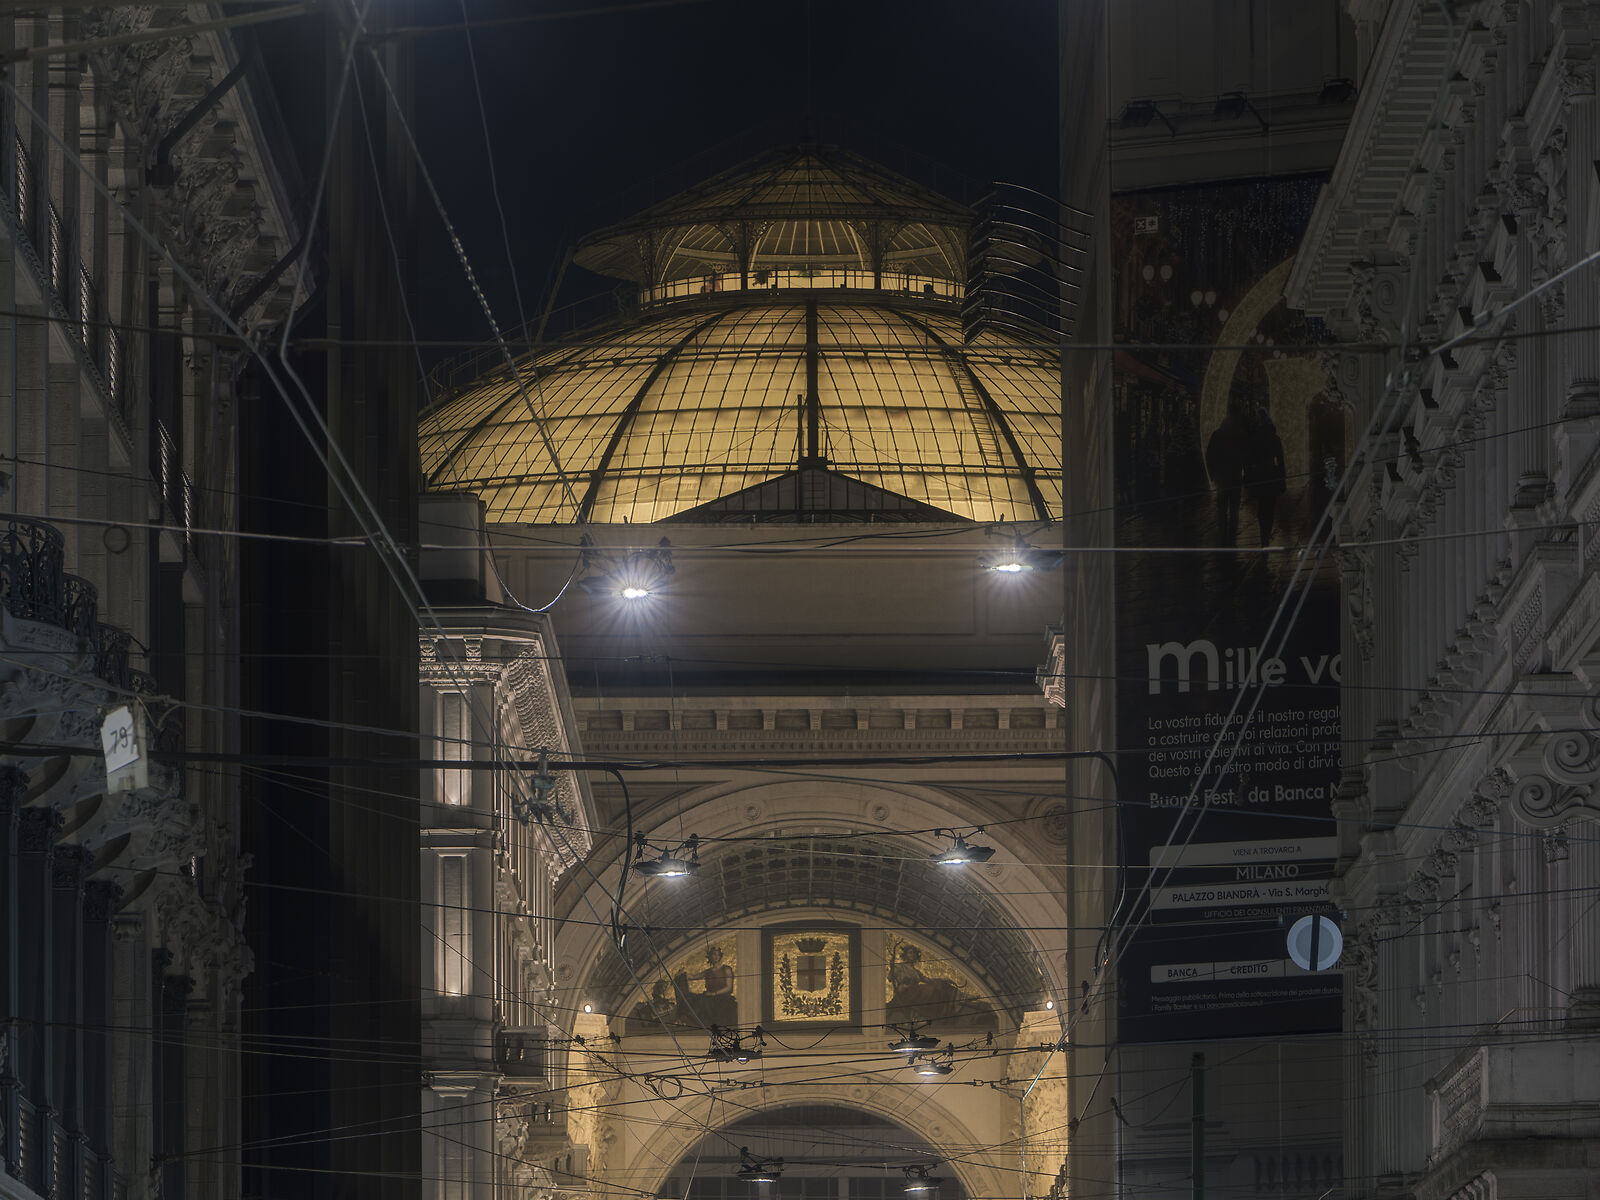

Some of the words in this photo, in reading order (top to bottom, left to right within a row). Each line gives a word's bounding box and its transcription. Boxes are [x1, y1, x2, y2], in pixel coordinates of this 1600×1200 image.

[1145, 639, 1287, 695] mille
[1148, 716, 1162, 730] La
[1166, 715, 1201, 729] vostra
[1258, 709, 1264, 723] il
[1268, 708, 1305, 722] nostro
[1308, 705, 1341, 722] regal
[1148, 736, 1156, 746] a
[1160, 730, 1210, 746] costruire
[1259, 723, 1309, 739] relazioni
[1296, 740, 1320, 753] Con
[1149, 764, 1191, 778] Questo
[1194, 762, 1202, 776] è
[1255, 757, 1290, 772] modo
[1293, 756, 1305, 769] di
[1308, 754, 1334, 769] dirvi
[1204, 788, 1240, 805] Fest
[1248, 785, 1270, 803] da
[1274, 784, 1324, 802] Banca
[1236, 864, 1299, 881] MILANO
[1172, 891, 1215, 903] PALAZZO
[1217, 887, 1261, 900] BIANDRÀ
[1268, 887, 1283, 898] Via
[1167, 967, 1198, 978] BANCA
[1230, 964, 1269, 975] CREDITO
